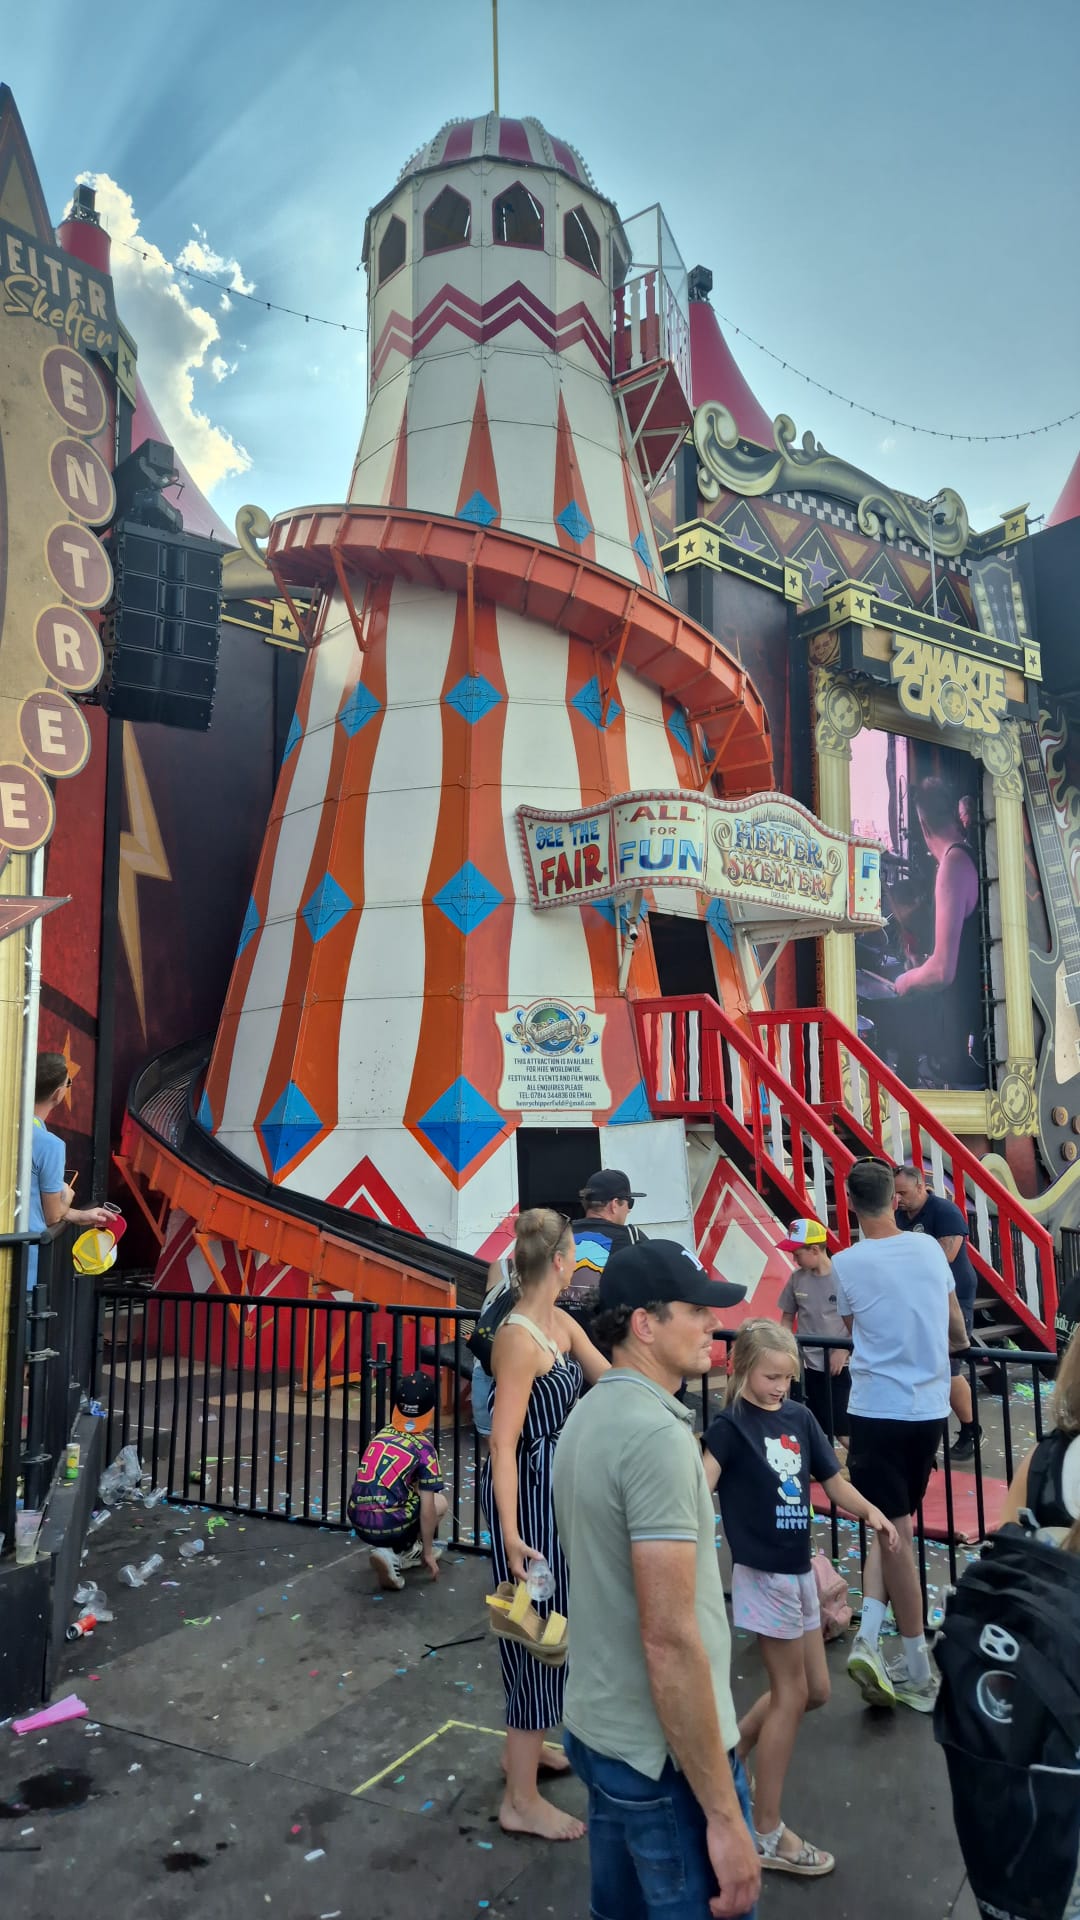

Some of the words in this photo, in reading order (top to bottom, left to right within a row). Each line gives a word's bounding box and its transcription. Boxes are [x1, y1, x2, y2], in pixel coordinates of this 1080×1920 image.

[0, 234, 108, 321] ELTER
[4, 274, 113, 349] Skelter
[892, 634, 1006, 706] ZWARTE
[535, 825, 564, 850] SEE
[569, 819, 600, 847] THE
[629, 805, 696, 823] ALL
[650, 826, 677, 836] FOR
[618, 838, 704, 875] FUN
[735, 818, 824, 869] HELTER
[540, 843, 604, 897] FAIR
[727, 851, 829, 903] SKELTER
[356, 1440, 415, 1490] 97
[775, 1504, 809, 1517] HELLO
[775, 1518, 808, 1530] KITTY
